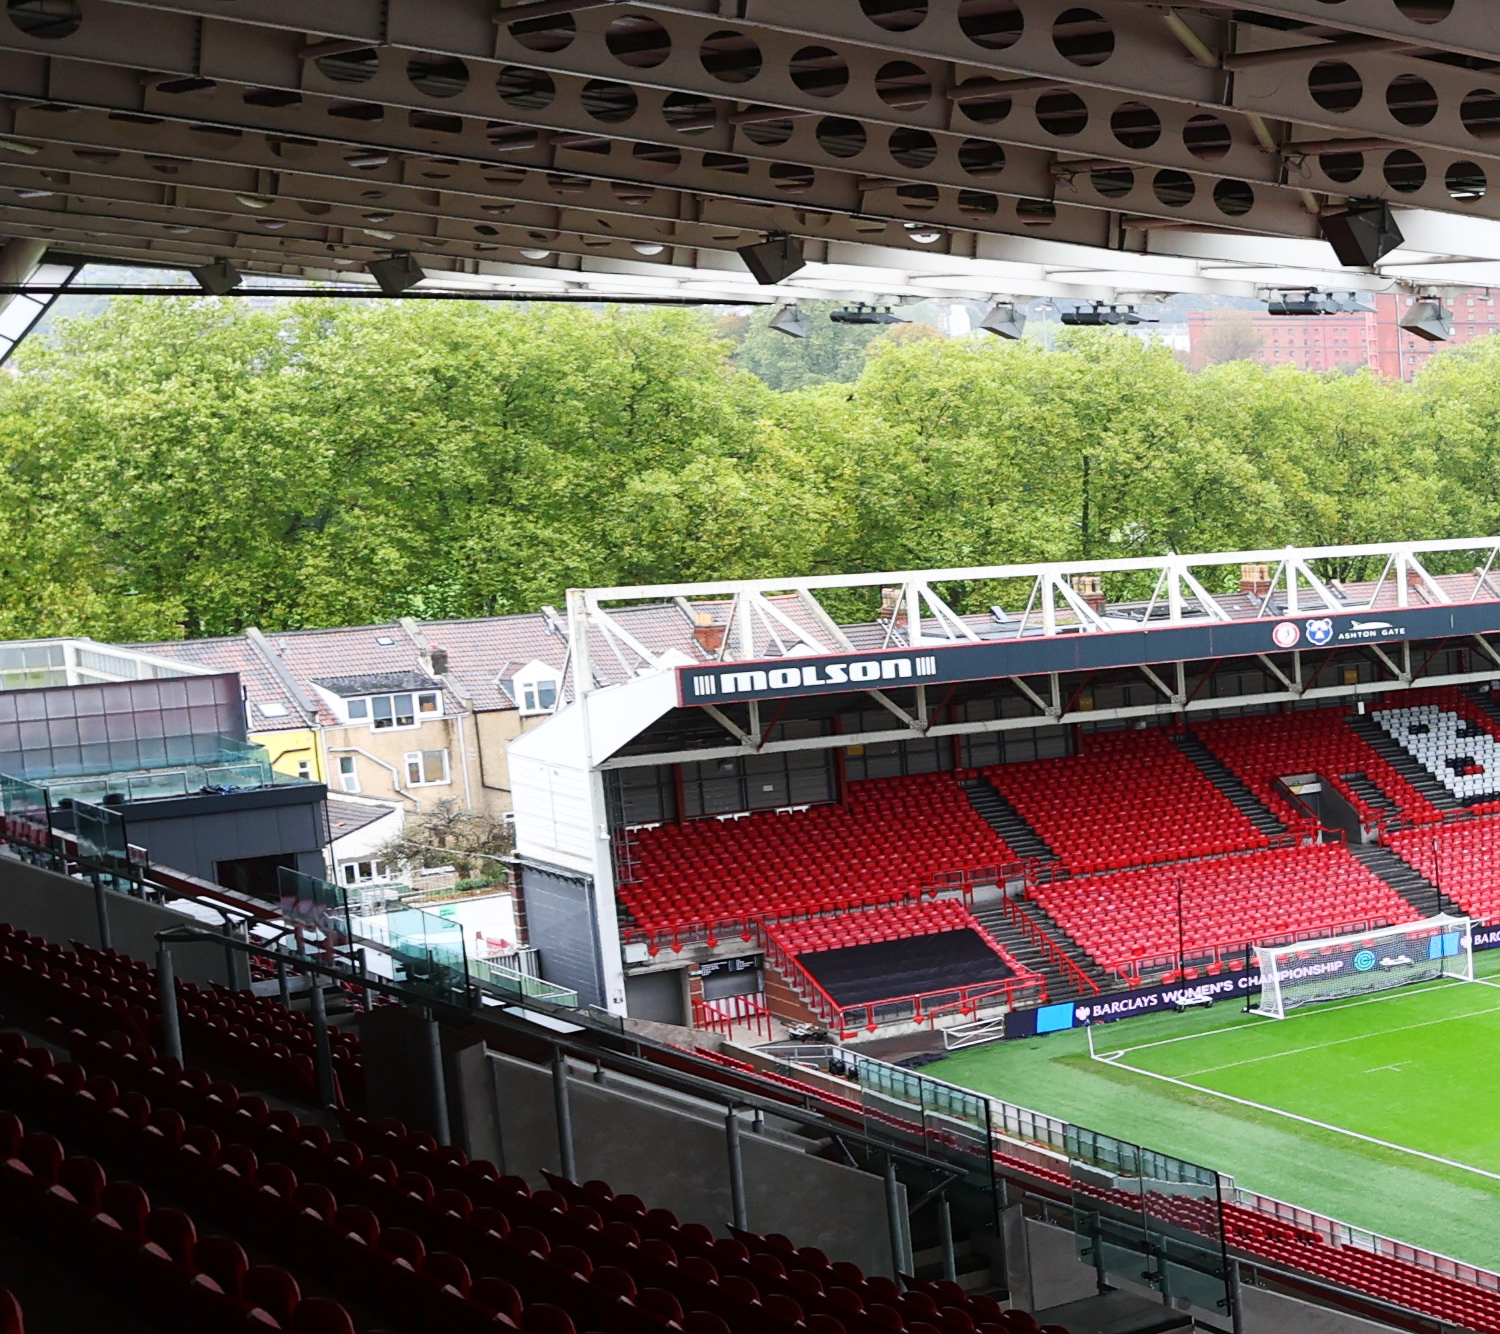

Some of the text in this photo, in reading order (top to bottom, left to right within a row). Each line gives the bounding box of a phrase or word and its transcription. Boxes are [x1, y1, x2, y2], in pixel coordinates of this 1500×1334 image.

[1338, 627, 1406, 640] ASHTON GATE
[720, 658, 912, 694] MOLSON
[1092, 993, 1158, 1018] BARCLAYS
[1161, 978, 1234, 1003] WOMEN'S
